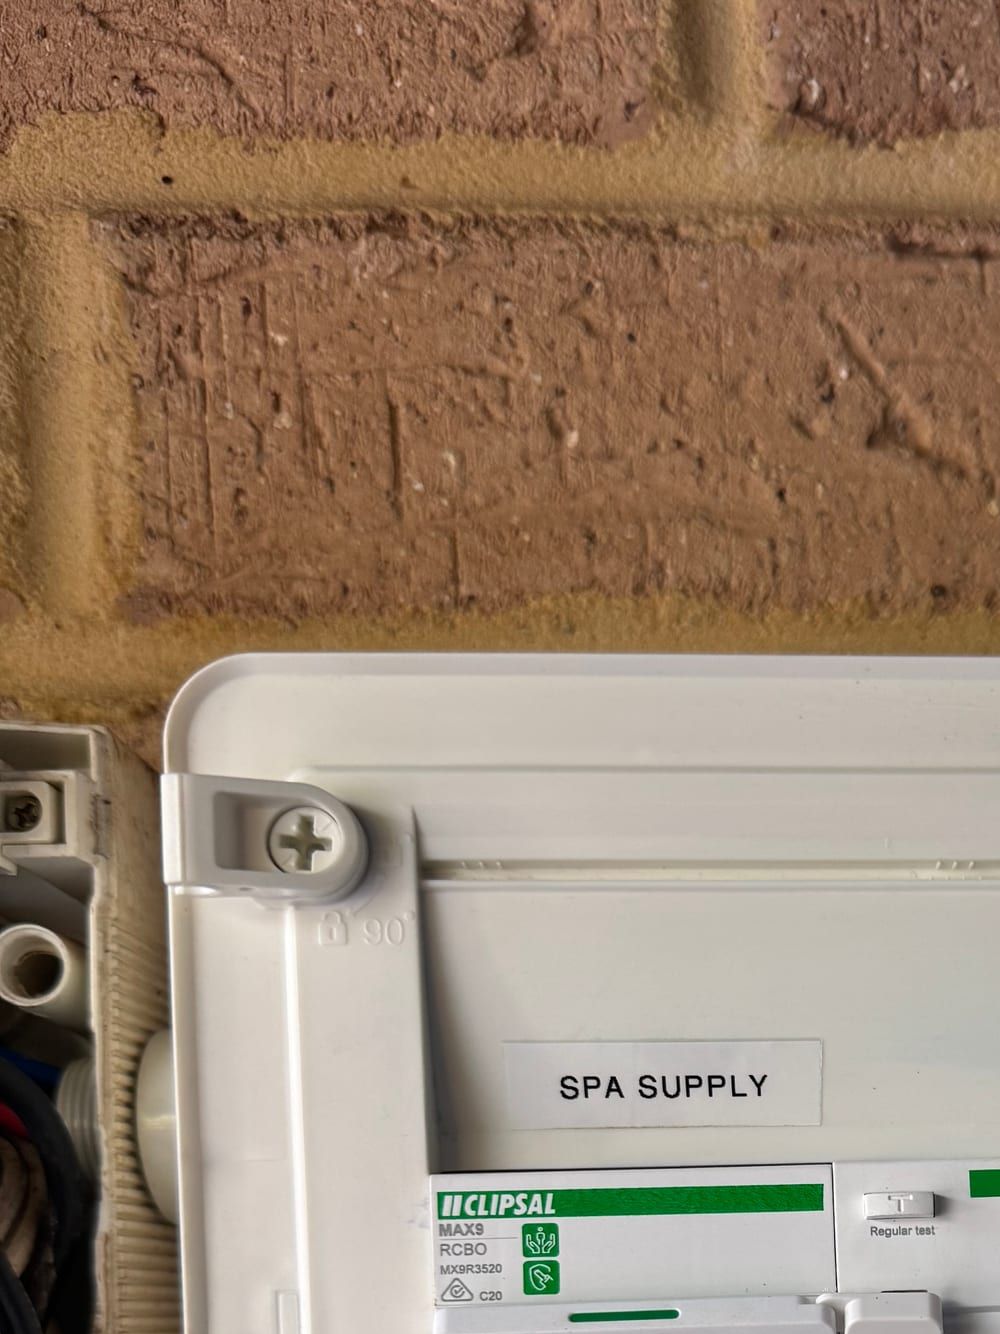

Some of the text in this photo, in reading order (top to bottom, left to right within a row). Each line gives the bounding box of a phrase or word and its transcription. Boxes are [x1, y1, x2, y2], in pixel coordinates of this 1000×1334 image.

[559, 1074, 768, 1100] SPA SUPPLY
[464, 1193, 556, 1216] CLIPSAL
[438, 1223, 485, 1237] MAX9
[870, 1225, 936, 1238] Regular test
[440, 1243, 488, 1257] RCBO
[439, 1264, 503, 1275] MX9R3520
[479, 1291, 503, 1302] C20
